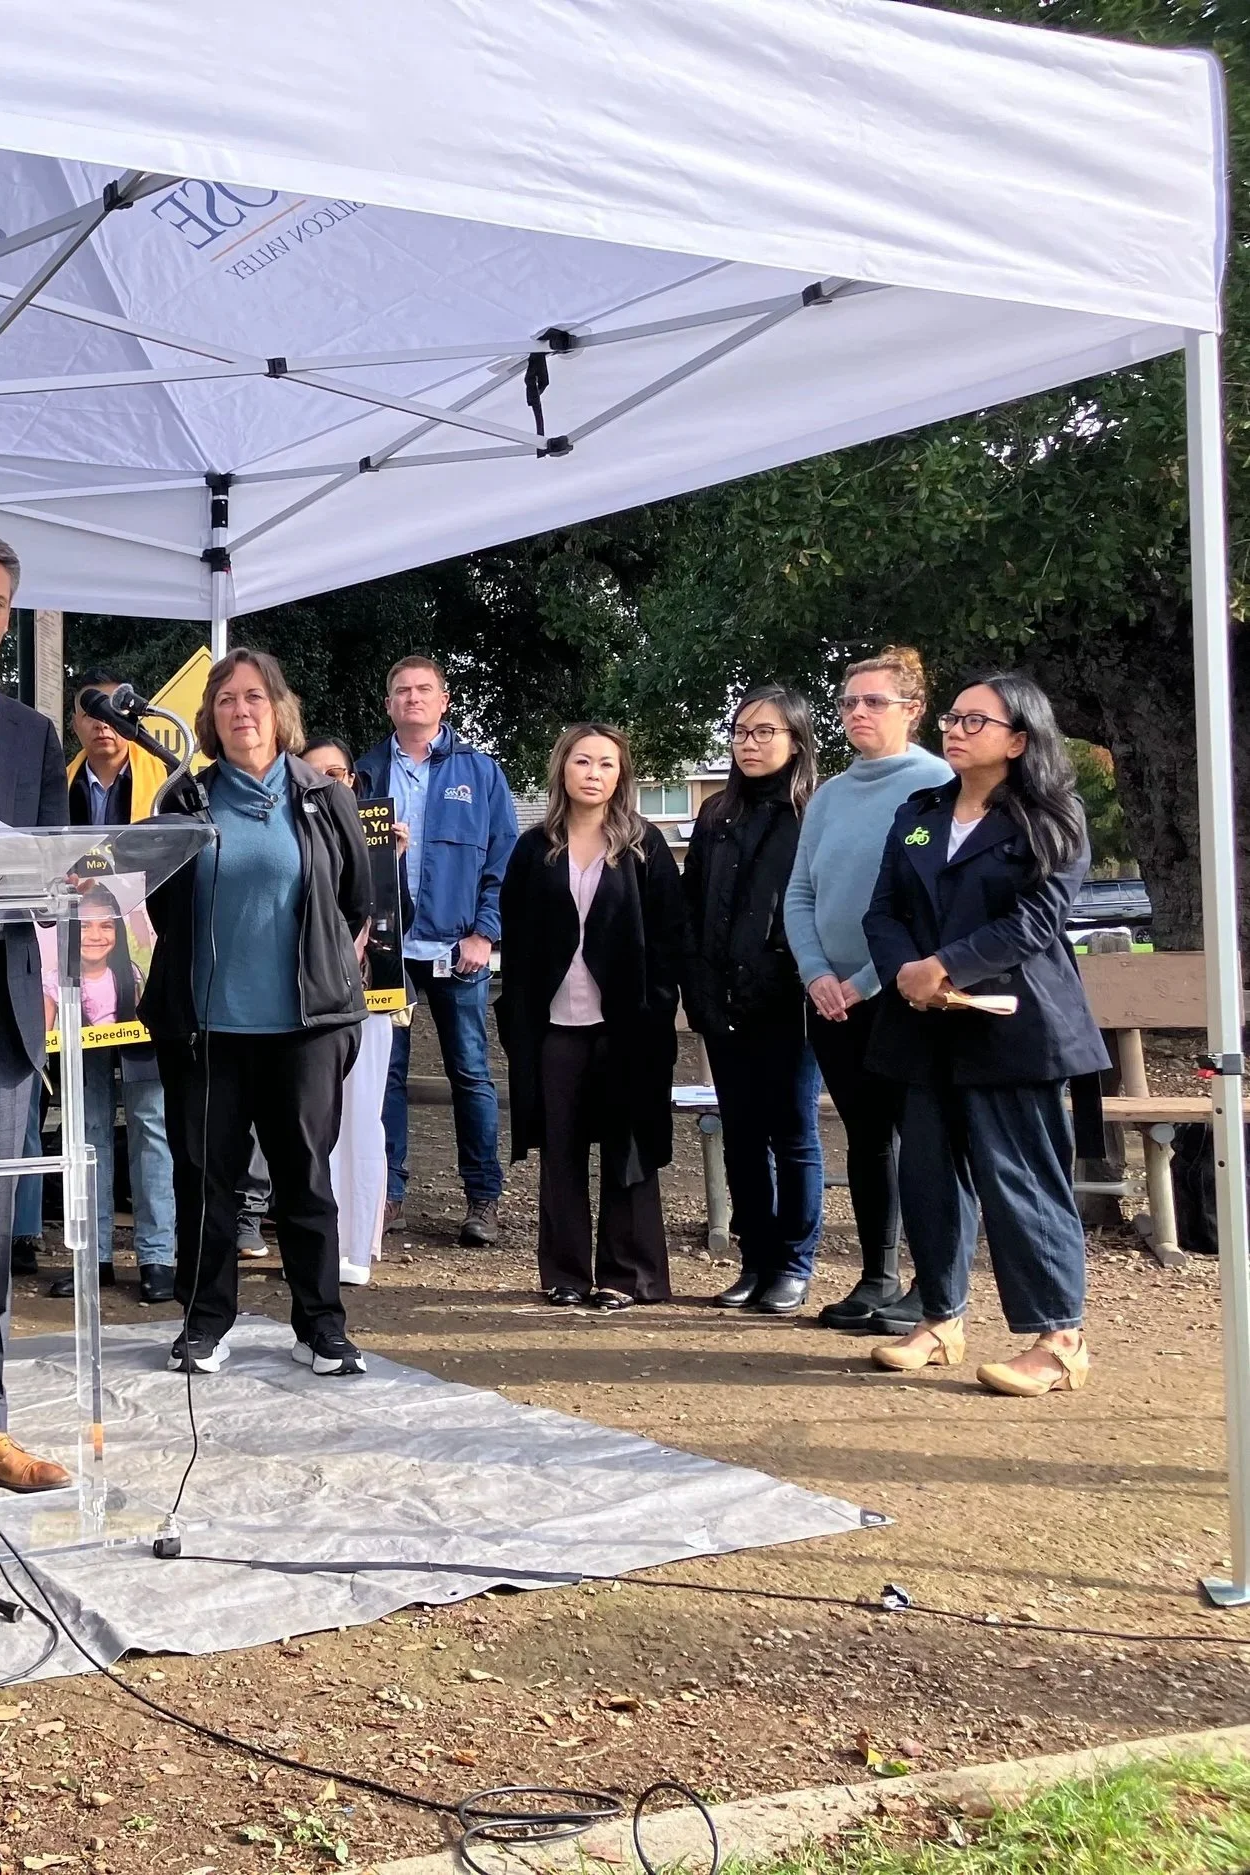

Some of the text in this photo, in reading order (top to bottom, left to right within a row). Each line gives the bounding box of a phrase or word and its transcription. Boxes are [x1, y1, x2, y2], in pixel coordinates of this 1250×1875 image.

[358, 806, 389, 819] zeto
[370, 820, 390, 833] Yu
[366, 835, 389, 846] 2011
[86, 860, 108, 870] May
[366, 995, 392, 1005] river
[88, 1028, 140, 1043] Speeding
